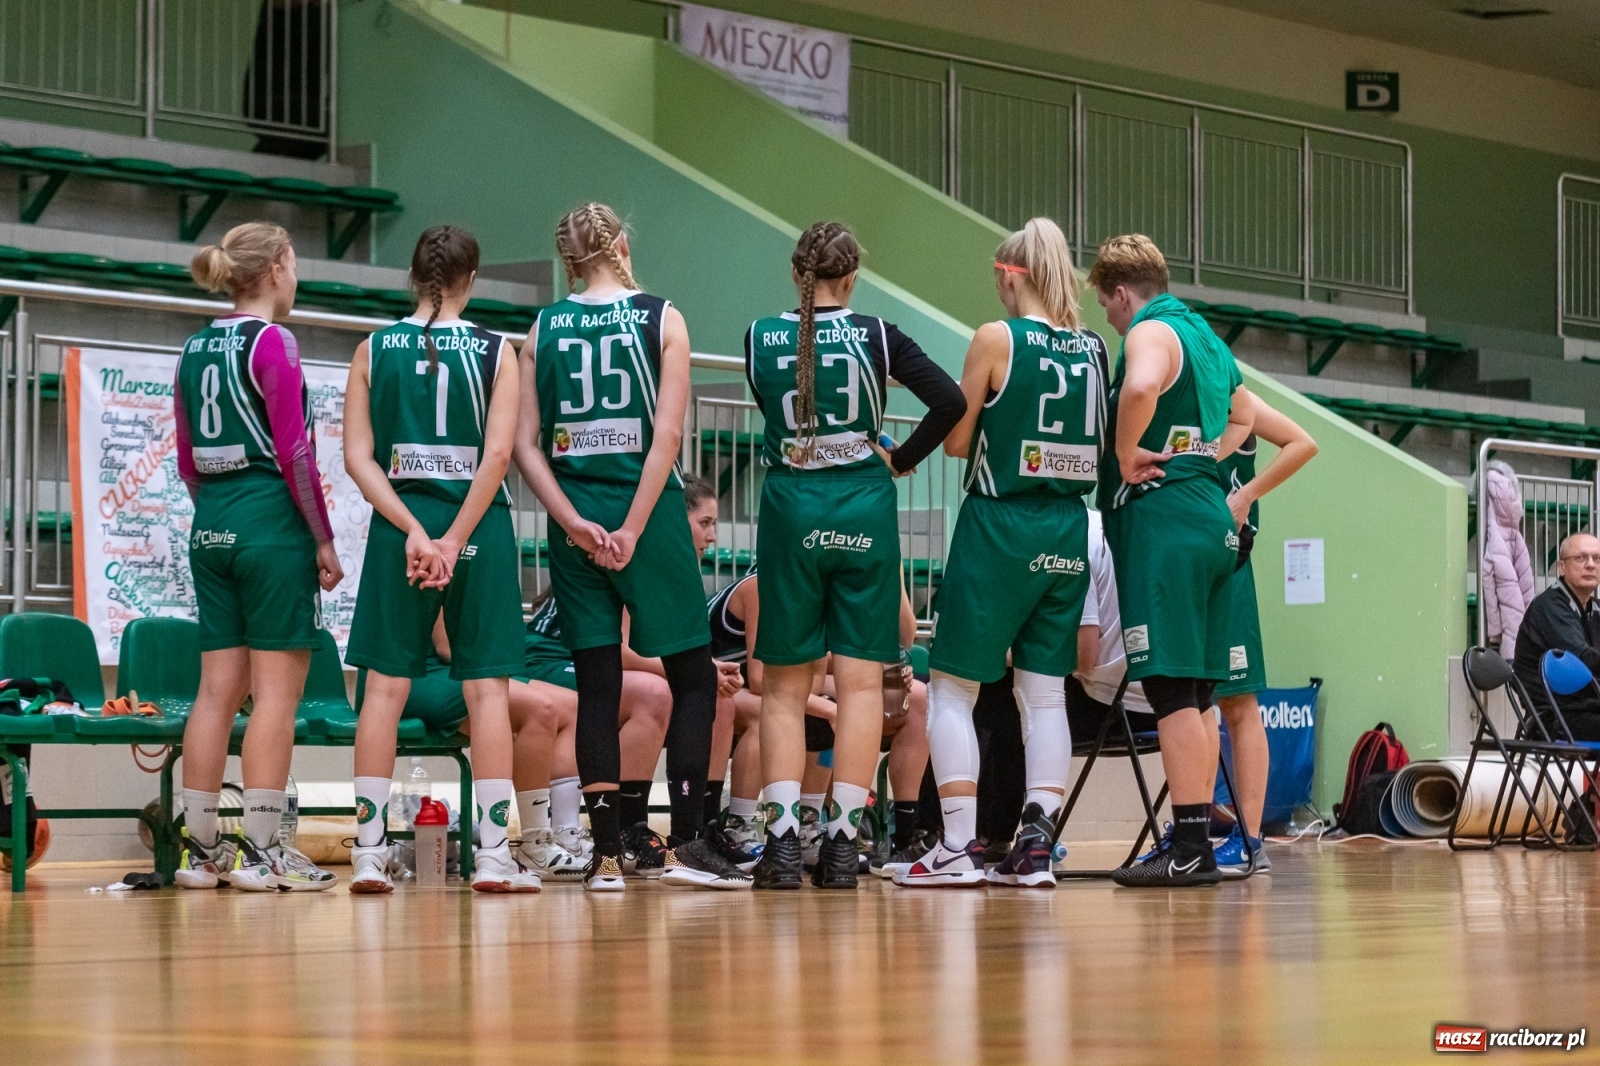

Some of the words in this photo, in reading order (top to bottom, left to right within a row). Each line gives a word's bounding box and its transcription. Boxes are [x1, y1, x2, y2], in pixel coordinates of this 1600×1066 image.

[701, 22, 832, 80] MIESZKO
[1357, 84, 1390, 107] D
[550, 314, 575, 330] RKK
[581, 304, 649, 327] RACIBÓRZ
[383, 333, 410, 349] RKK
[763, 331, 790, 347] RKK
[558, 333, 634, 415] 35
[200, 364, 223, 439] 8
[416, 360, 449, 436] 7
[1038, 358, 1097, 436] 27
[571, 427, 616, 437] wydawnictwo
[572, 433, 637, 449] WAGTECH
[401, 450, 451, 460] wydawnictwo
[401, 459, 472, 473] WAGTECH
[201, 530, 237, 545] Clavis
[820, 531, 873, 548] Clavis
[1044, 555, 1085, 571] Clavis
